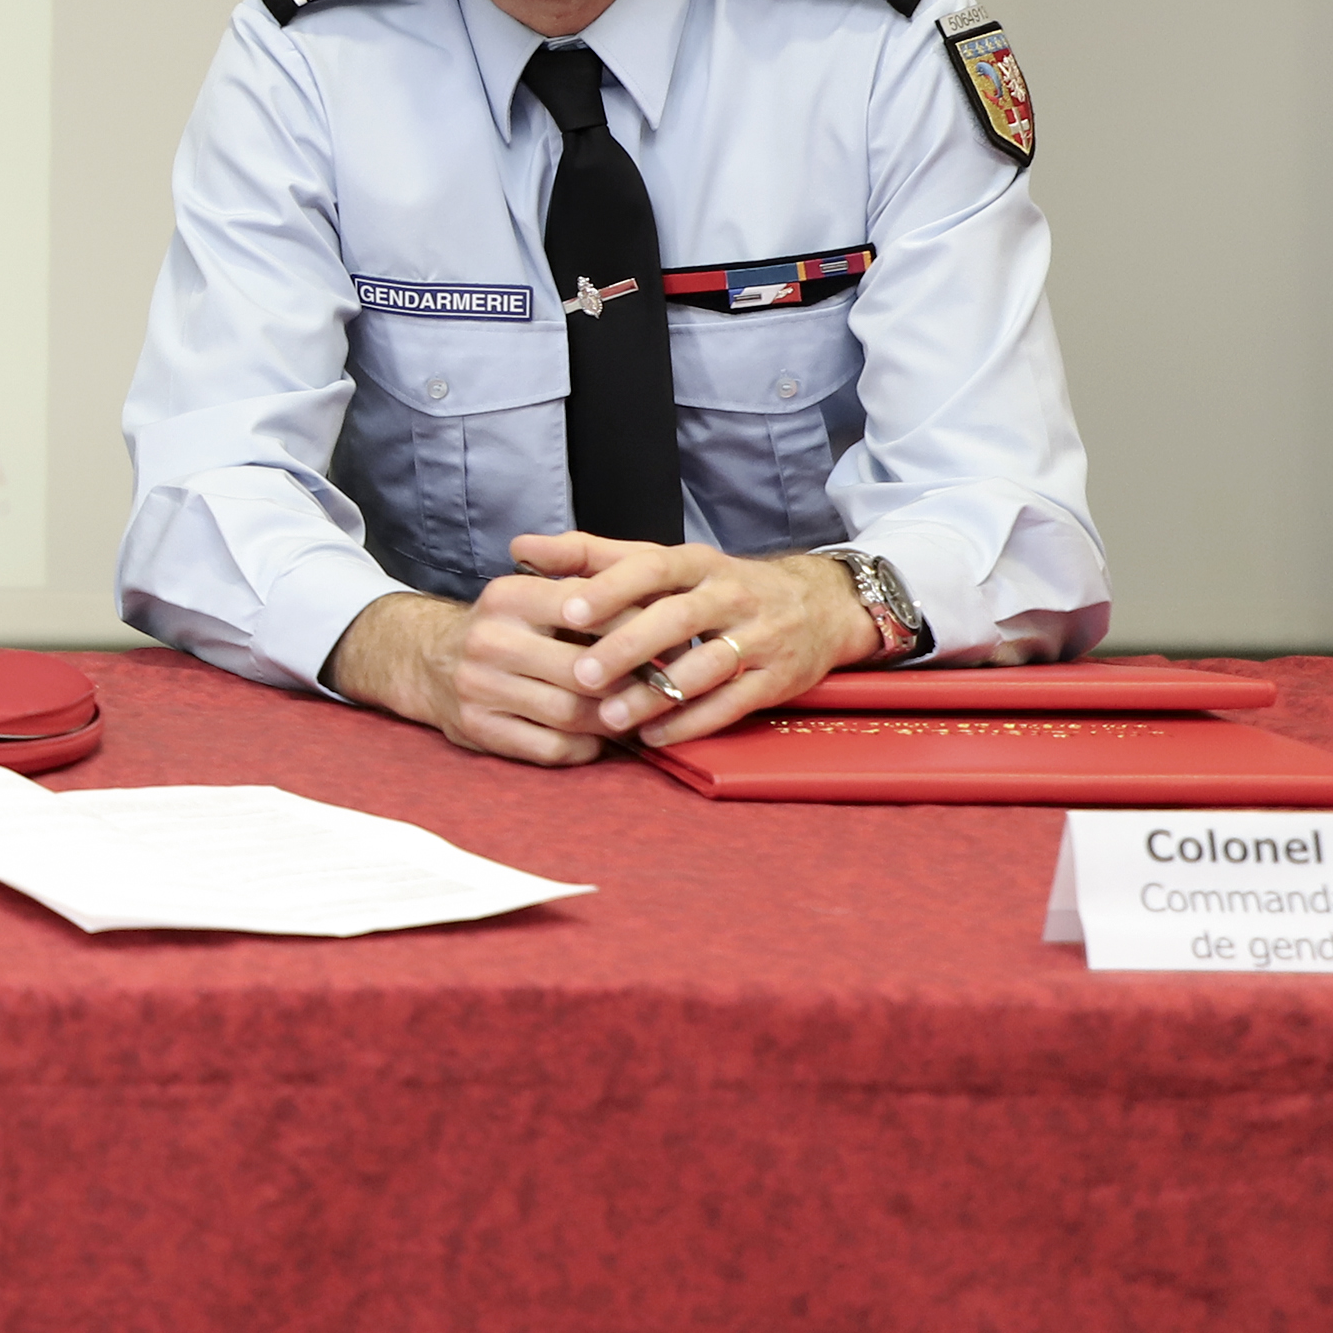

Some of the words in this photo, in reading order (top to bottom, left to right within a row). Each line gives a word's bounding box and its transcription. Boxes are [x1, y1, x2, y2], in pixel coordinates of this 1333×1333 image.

[359, 284, 525, 313] GENDARMERIE
[1145, 829, 1324, 865] Colonel
[1139, 881, 1332, 914] Command
[1190, 931, 1235, 960] de
[1248, 931, 1333, 969] gend
